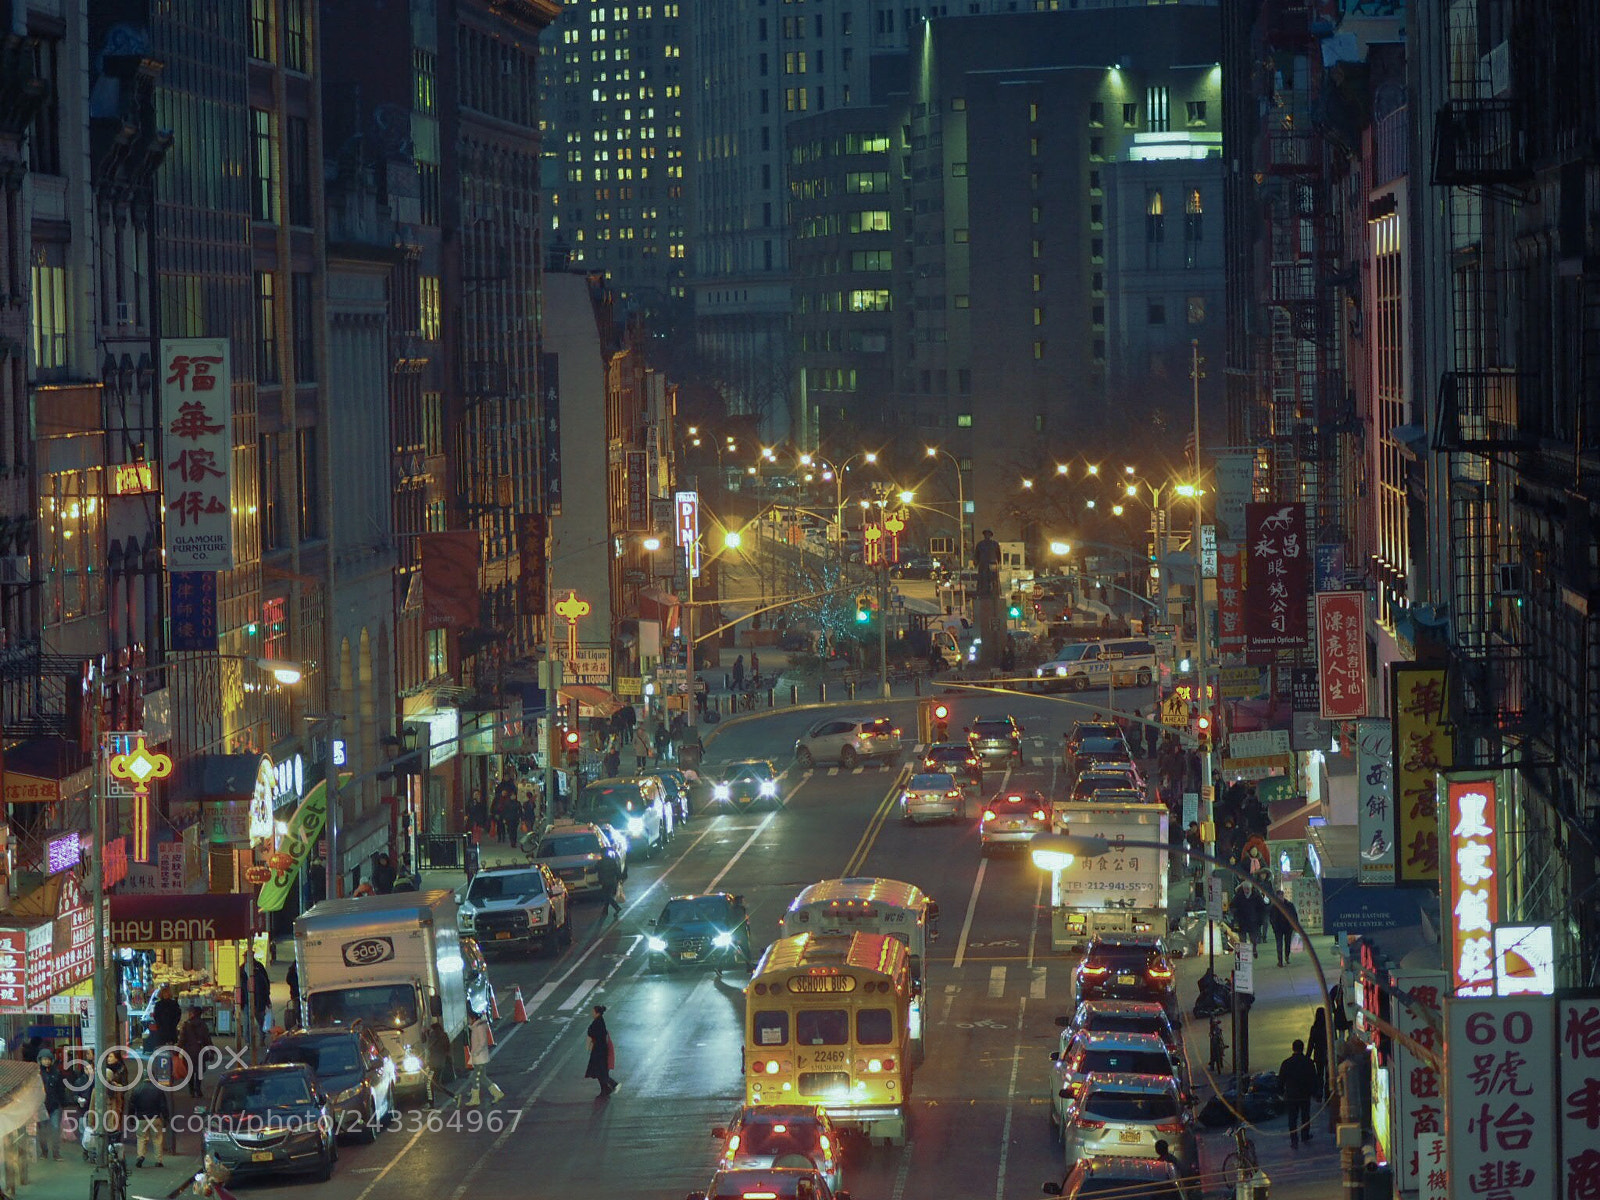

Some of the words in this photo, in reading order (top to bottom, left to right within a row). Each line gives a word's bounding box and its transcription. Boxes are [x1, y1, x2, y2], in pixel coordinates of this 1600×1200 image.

[166, 355, 225, 527] 福華傢俬
[175, 535, 223, 544] GLAMOUR
[173, 543, 227, 553] FURNITURE
[193, 552, 208, 560] CO.
[1266, 558, 1288, 632] 眼鏡公司
[1252, 636, 1276, 645] Universal
[1277, 636, 1295, 646] Optical
[588, 651, 607, 661] Liquor
[1324, 612, 1347, 700] 漂亮人生
[1366, 764, 1388, 853] 西餅屋
[1082, 857, 1138, 871] 肉食公司
[160, 918, 215, 940] BANK
[353, 943, 383, 960] edge
[797, 977, 828, 991] SCHOOL
[832, 977, 847, 991] BUS
[1465, 1011, 1533, 1045] 60
[814, 1051, 845, 1062] 22469
